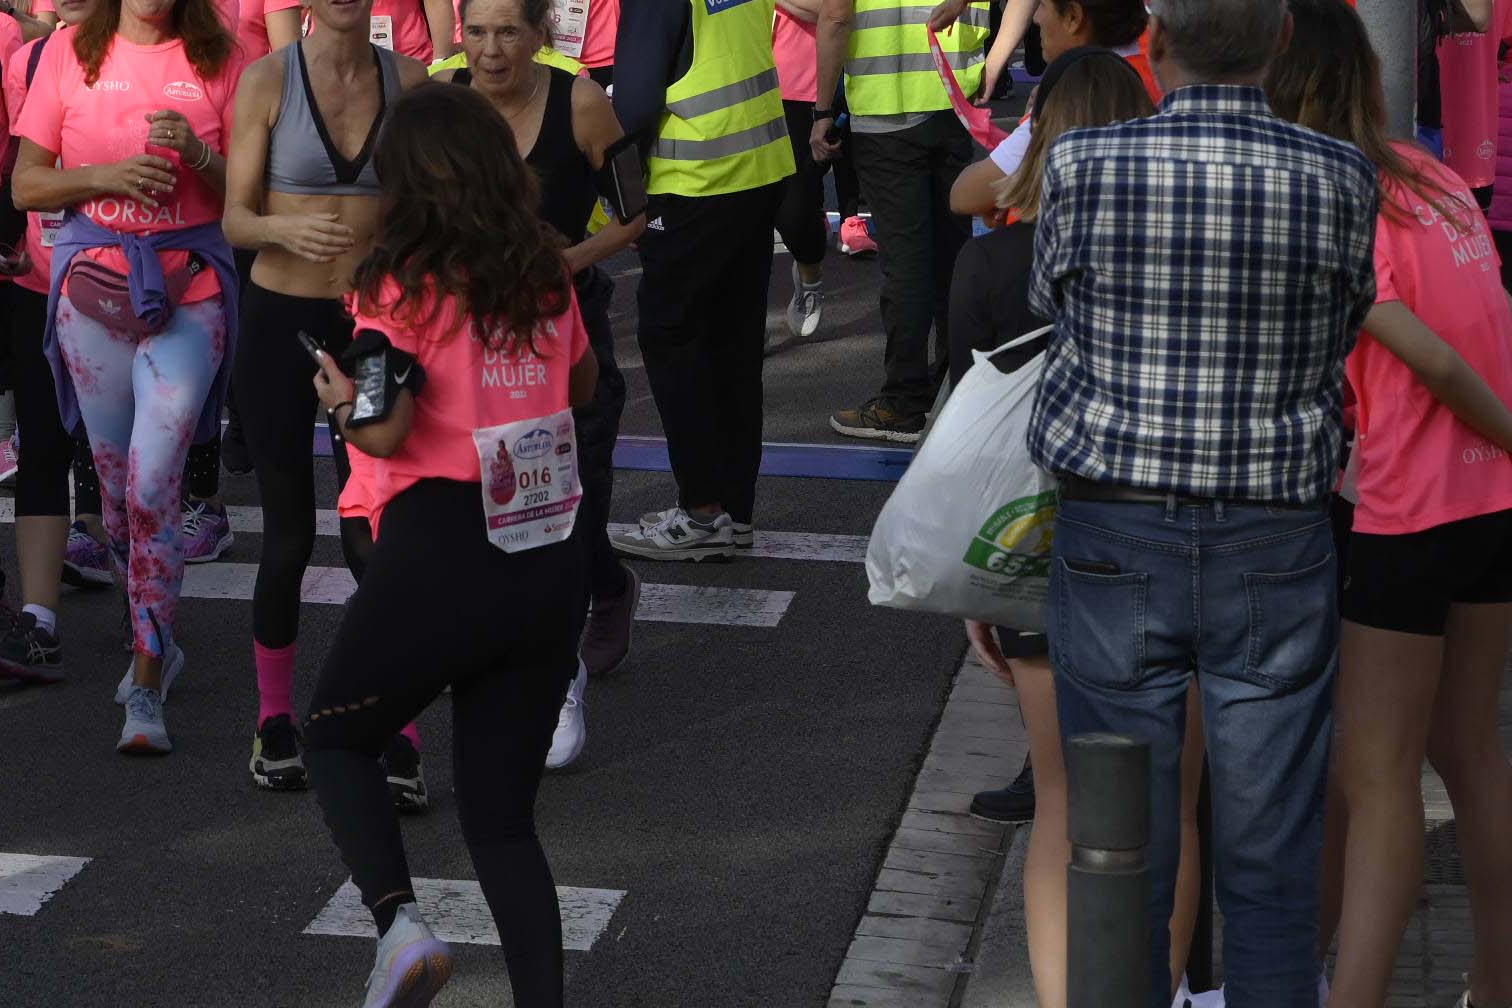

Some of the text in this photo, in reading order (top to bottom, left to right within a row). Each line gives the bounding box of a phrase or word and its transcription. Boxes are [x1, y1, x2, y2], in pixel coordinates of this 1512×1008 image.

[481, 364, 547, 388] MUJER
[519, 467, 552, 489] 016
[524, 490, 550, 506] 27202
[498, 512, 526, 525] CARRERA
